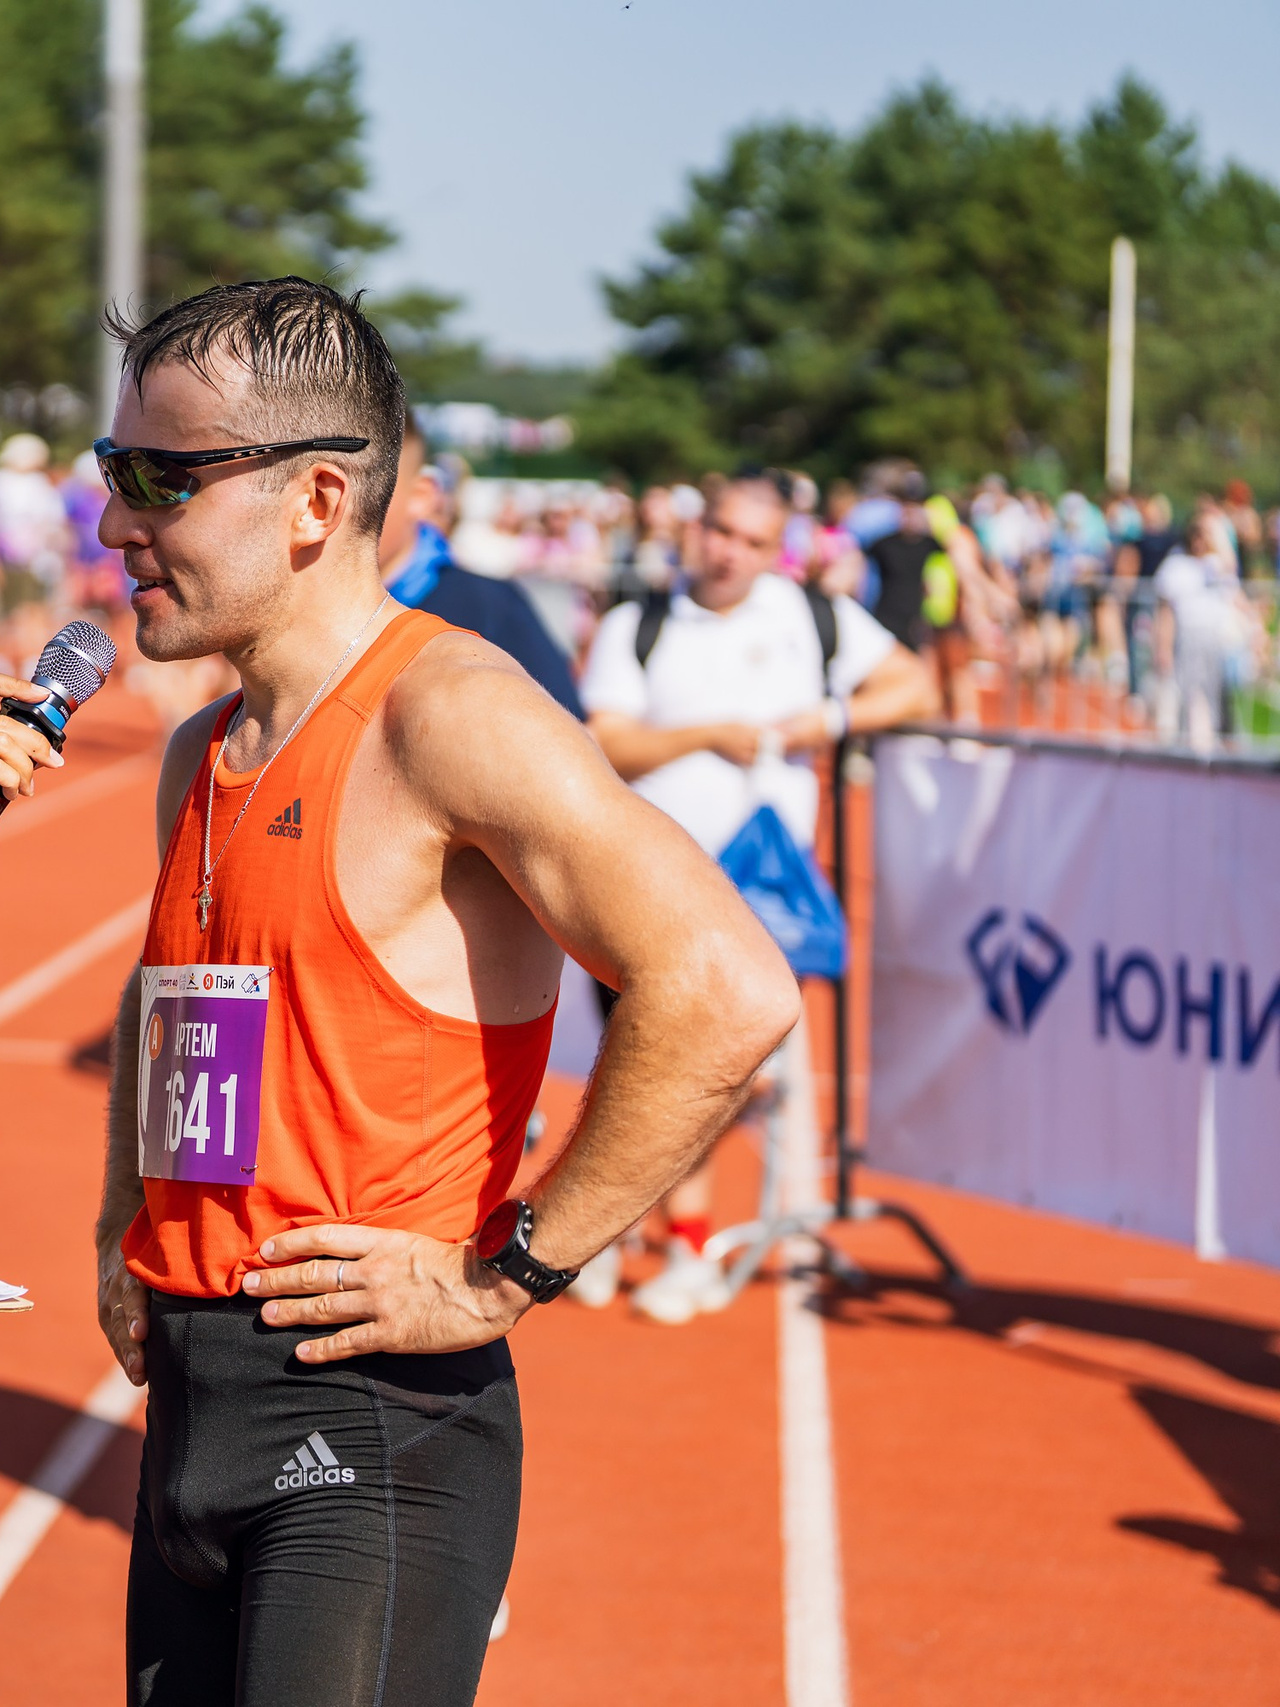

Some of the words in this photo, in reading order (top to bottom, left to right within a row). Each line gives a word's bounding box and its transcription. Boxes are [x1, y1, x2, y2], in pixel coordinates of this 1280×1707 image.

[267, 822, 303, 840] adidas
[215, 975, 235, 989] Пэй
[1091, 940, 1280, 1073] ЮНИ
[174, 1022, 218, 1058] АРТЕМ
[164, 1070, 238, 1156] 1641
[274, 1465, 356, 1491] adidas
